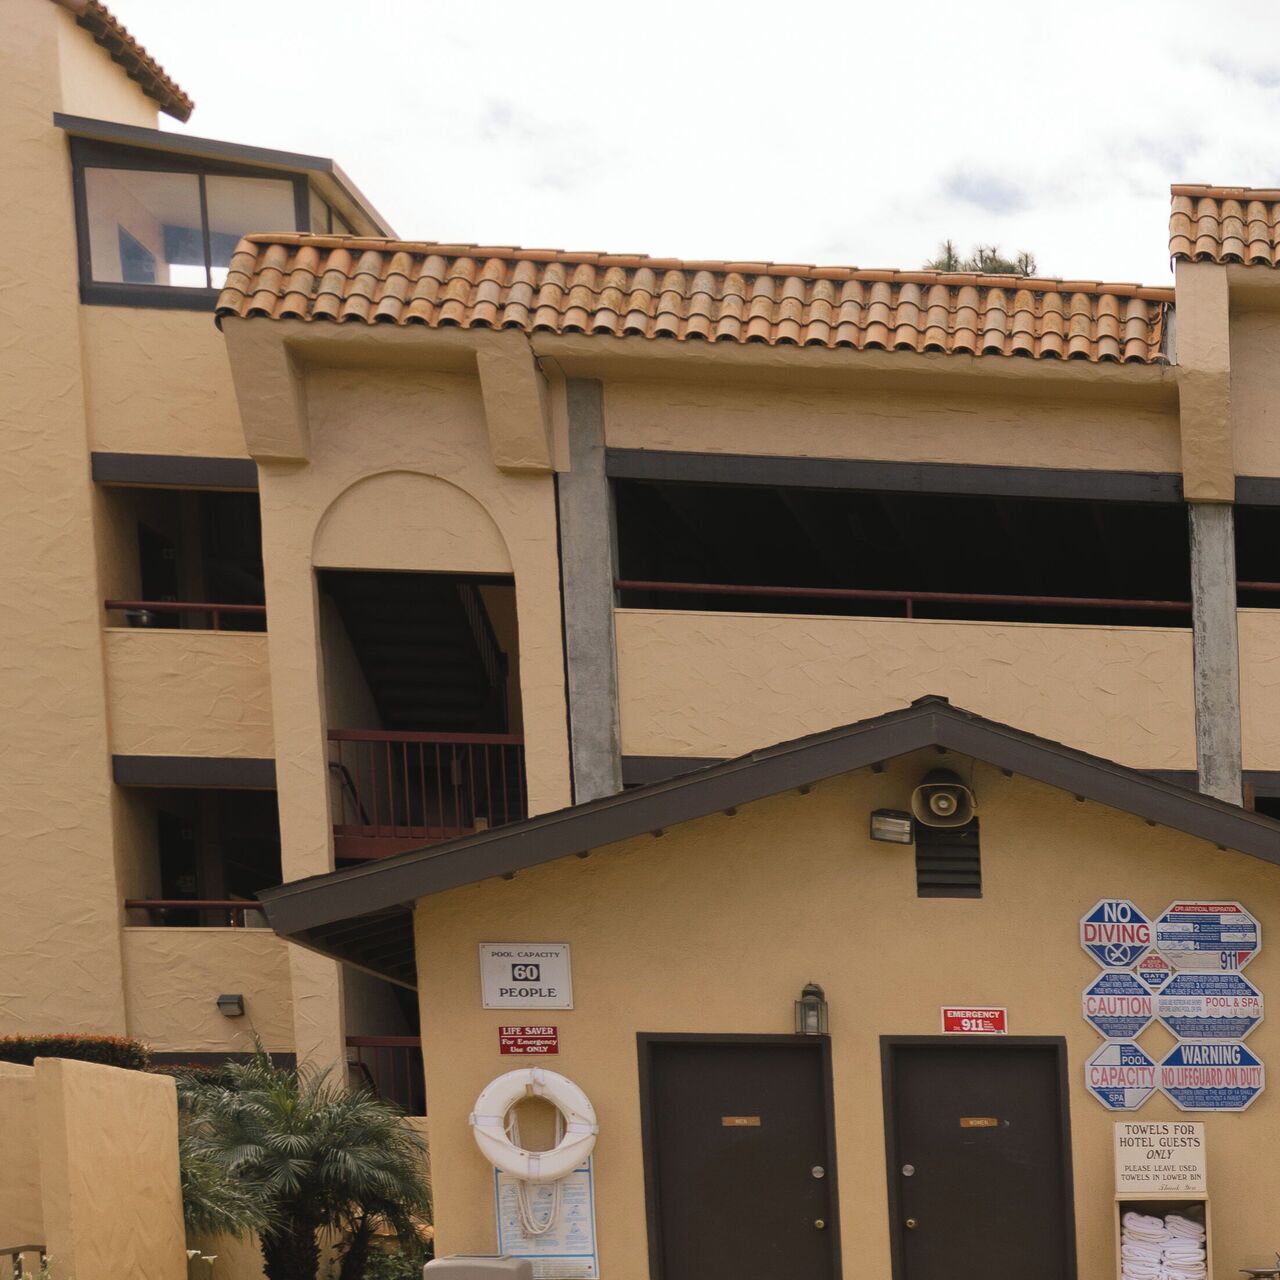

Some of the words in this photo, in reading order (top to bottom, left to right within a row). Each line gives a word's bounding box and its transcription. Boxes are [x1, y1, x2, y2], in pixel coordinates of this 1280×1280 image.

[1103, 903, 1131, 923] NO
[1084, 923, 1150, 943] DIVING
[1194, 924, 1200, 932] 2
[1220, 951, 1238, 970] 911
[513, 965, 539, 980] 60
[500, 988, 557, 998] PEOPLE
[1087, 996, 1152, 1015] CAUTION
[1205, 997, 1231, 1007] POOL
[1233, 998, 1239, 1007] &
[1241, 998, 1259, 1007] SPA
[947, 1010, 1000, 1018] EMERGENCY
[961, 1019, 984, 1031] 911
[503, 1027, 521, 1035] LIFE
[525, 1027, 554, 1035] SAVER
[1122, 1056, 1147, 1065] POOL
[1181, 1045, 1241, 1065] WARNING
[1090, 1067, 1155, 1086] CAPACITY
[1161, 1067, 1174, 1086] NO
[1177, 1067, 1222, 1086] LIFEGUARD
[1225, 1067, 1238, 1086] ON
[1240, 1067, 1261, 1086] DUTY
[1108, 1094, 1124, 1102] SPA
[1125, 1125, 1169, 1135] TOWELS
[1174, 1125, 1195, 1135] FOR
[1119, 1138, 1155, 1147] HOTEL
[1159, 1137, 1200, 1148] GUESTS
[1146, 1150, 1174, 1160] ONLY
